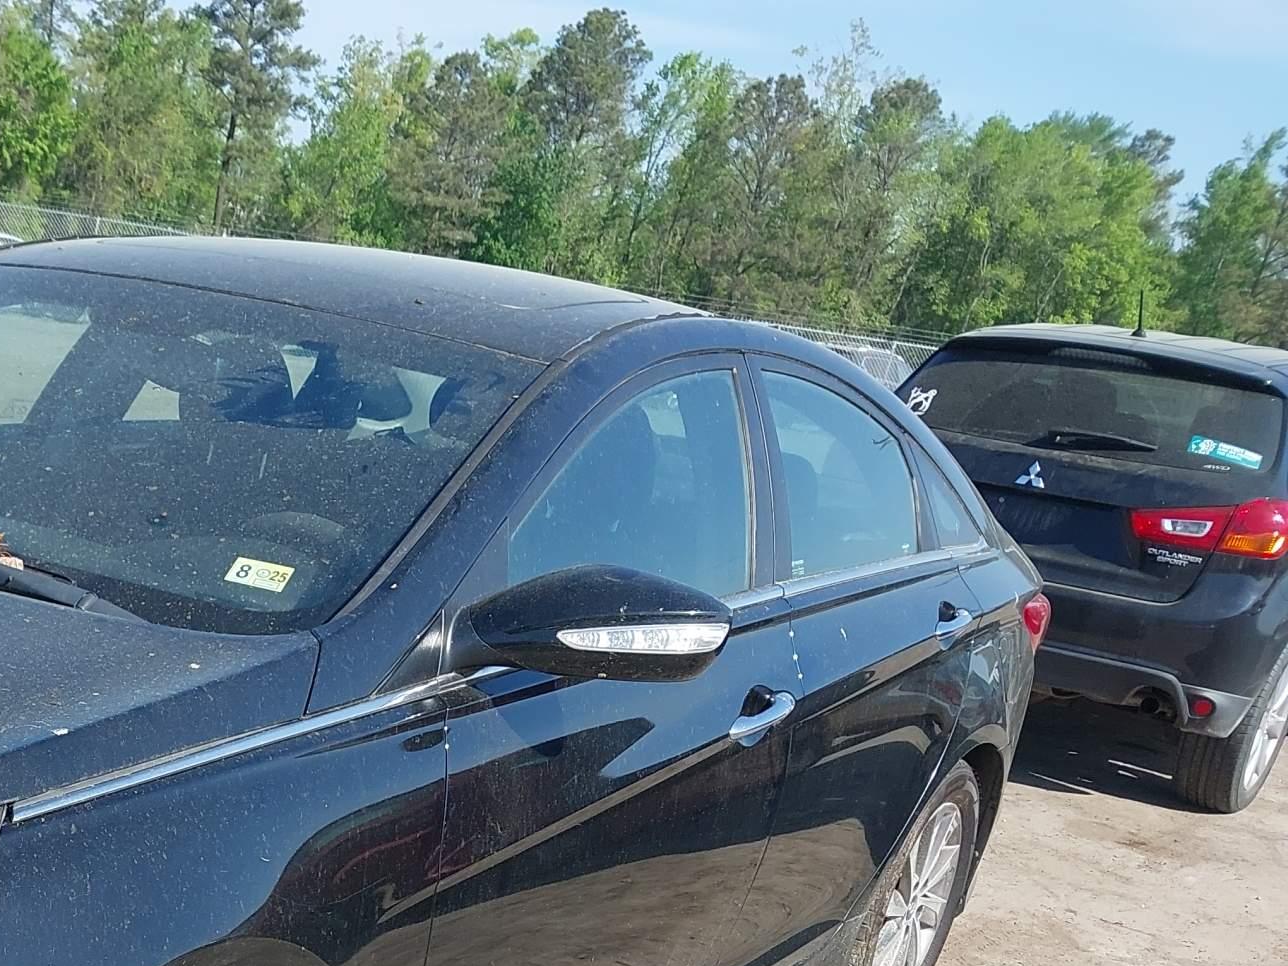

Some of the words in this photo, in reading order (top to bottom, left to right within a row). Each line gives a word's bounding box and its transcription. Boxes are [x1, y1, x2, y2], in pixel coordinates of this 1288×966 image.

[1147, 547, 1202, 563] OUTLANDER
[1157, 556, 1188, 567] SPORT
[235, 564, 252, 578] 8
[269, 570, 289, 583] 25
